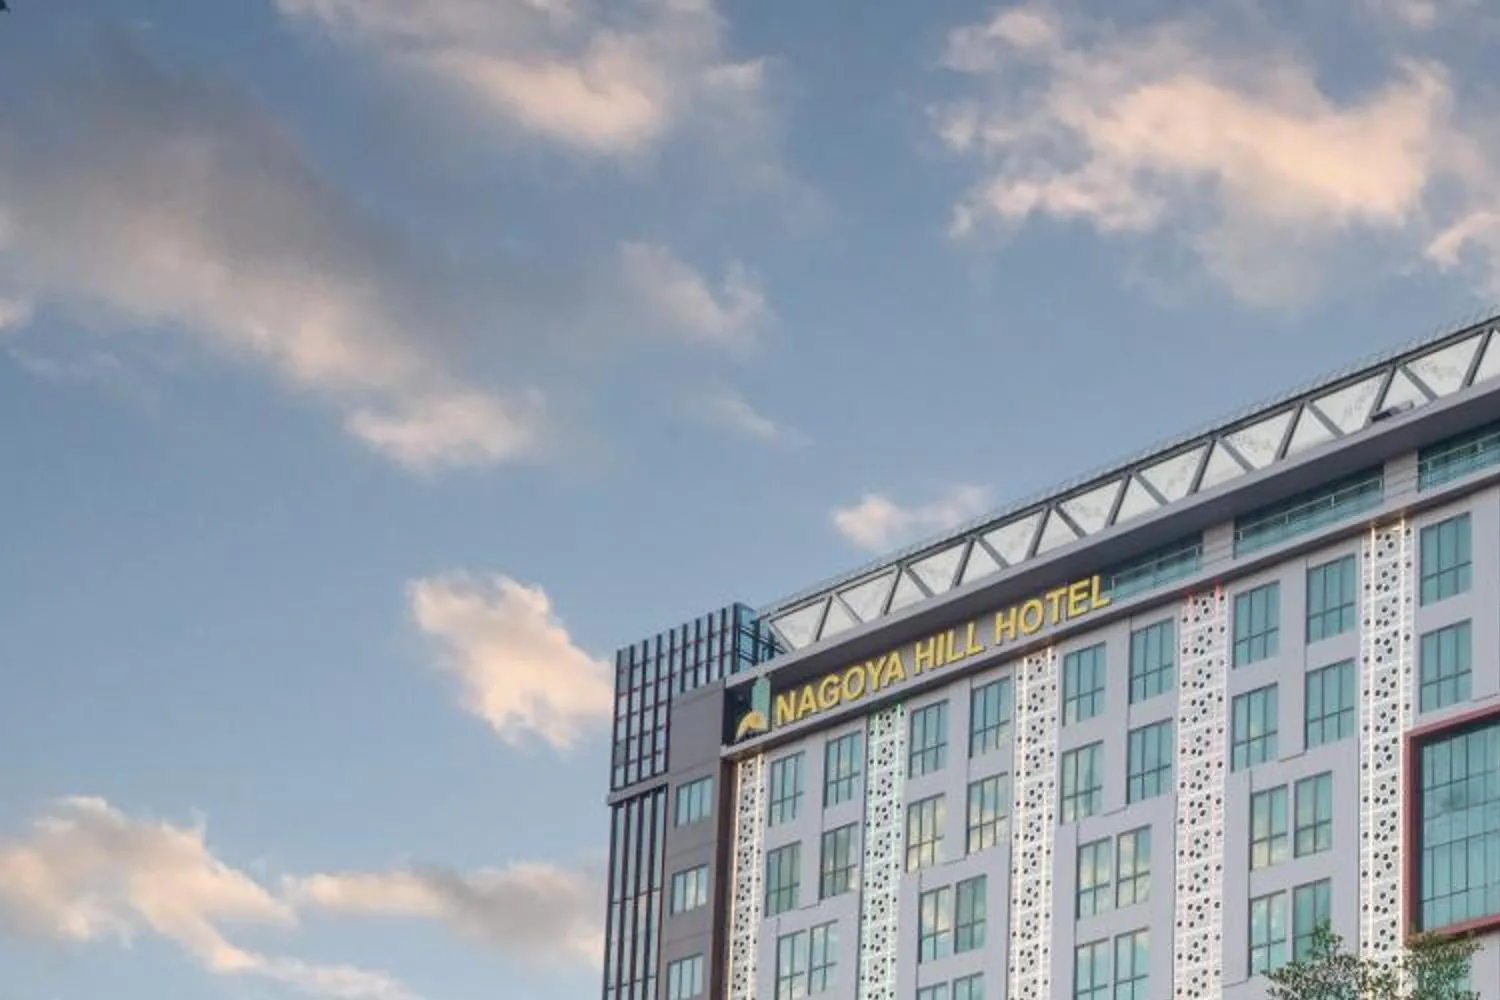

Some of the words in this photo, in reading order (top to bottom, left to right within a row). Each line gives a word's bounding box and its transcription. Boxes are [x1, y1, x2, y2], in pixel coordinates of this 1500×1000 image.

[775, 656, 906, 727] NAGOYA
[913, 621, 985, 675] HILL
[994, 575, 1112, 647] HOTEL
